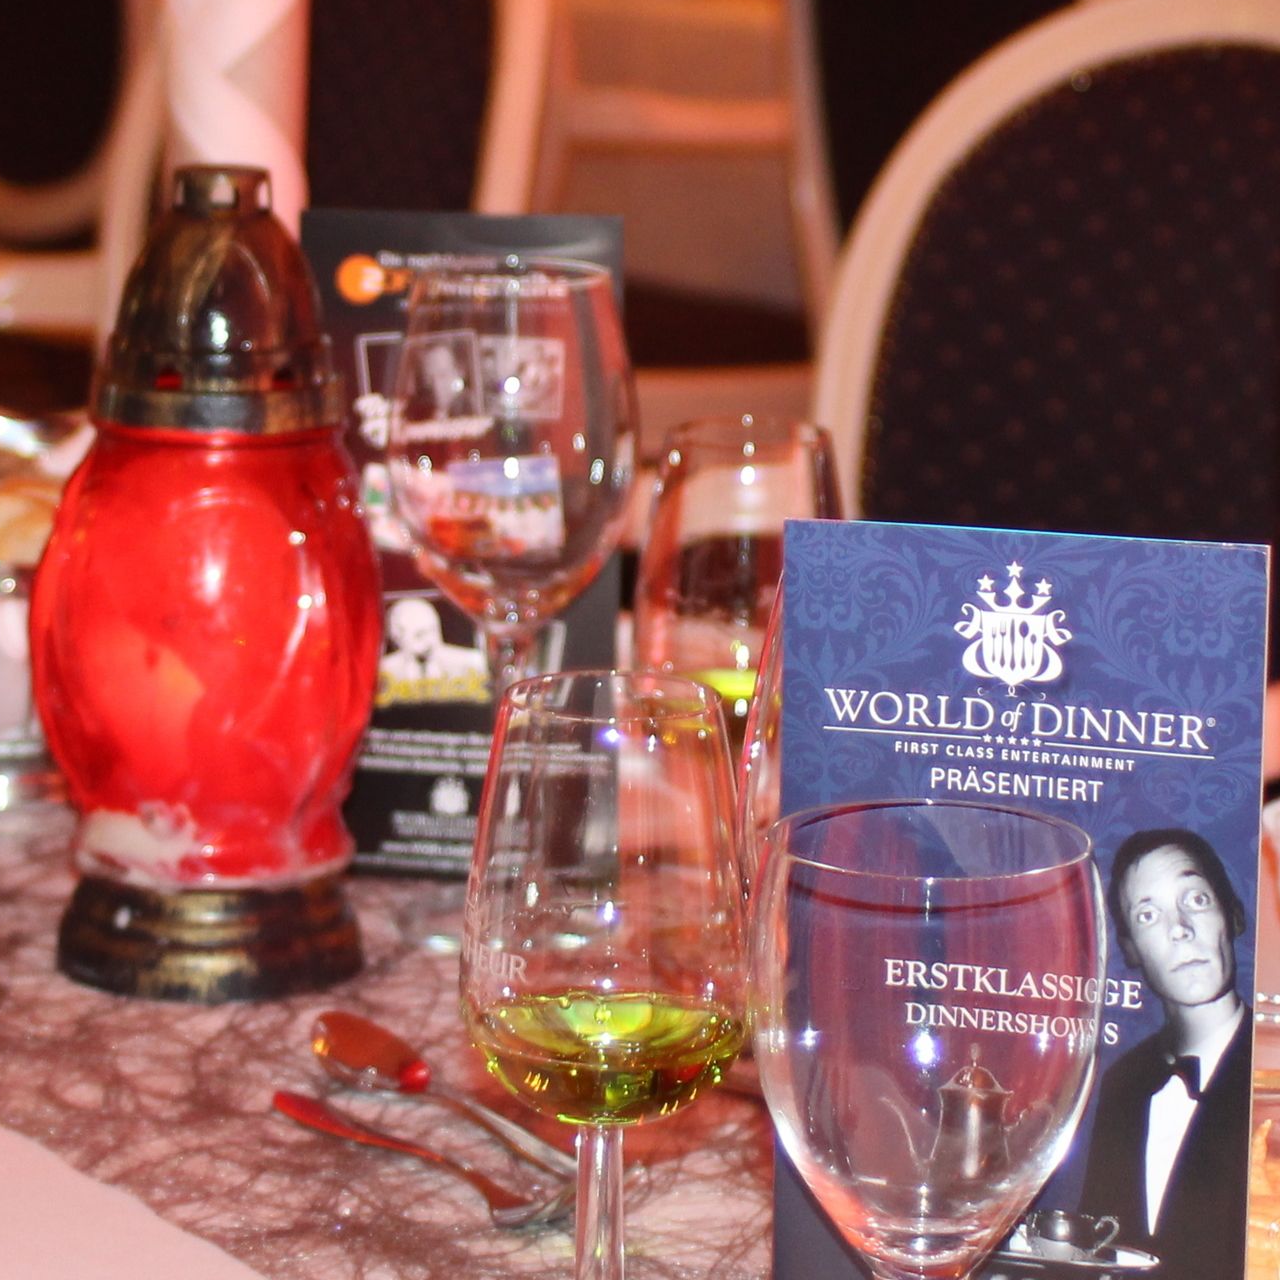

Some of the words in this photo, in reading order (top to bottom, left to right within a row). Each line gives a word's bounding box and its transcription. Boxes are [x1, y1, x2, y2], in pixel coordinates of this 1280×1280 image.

[823, 688, 995, 731] WORLD
[1000, 701, 1026, 732] of
[895, 741, 939, 755] FIRST
[946, 745, 995, 759] CLASS
[1001, 748, 1135, 771] ENTERTAINMENT
[930, 766, 1104, 803] PRÄSENTIERT
